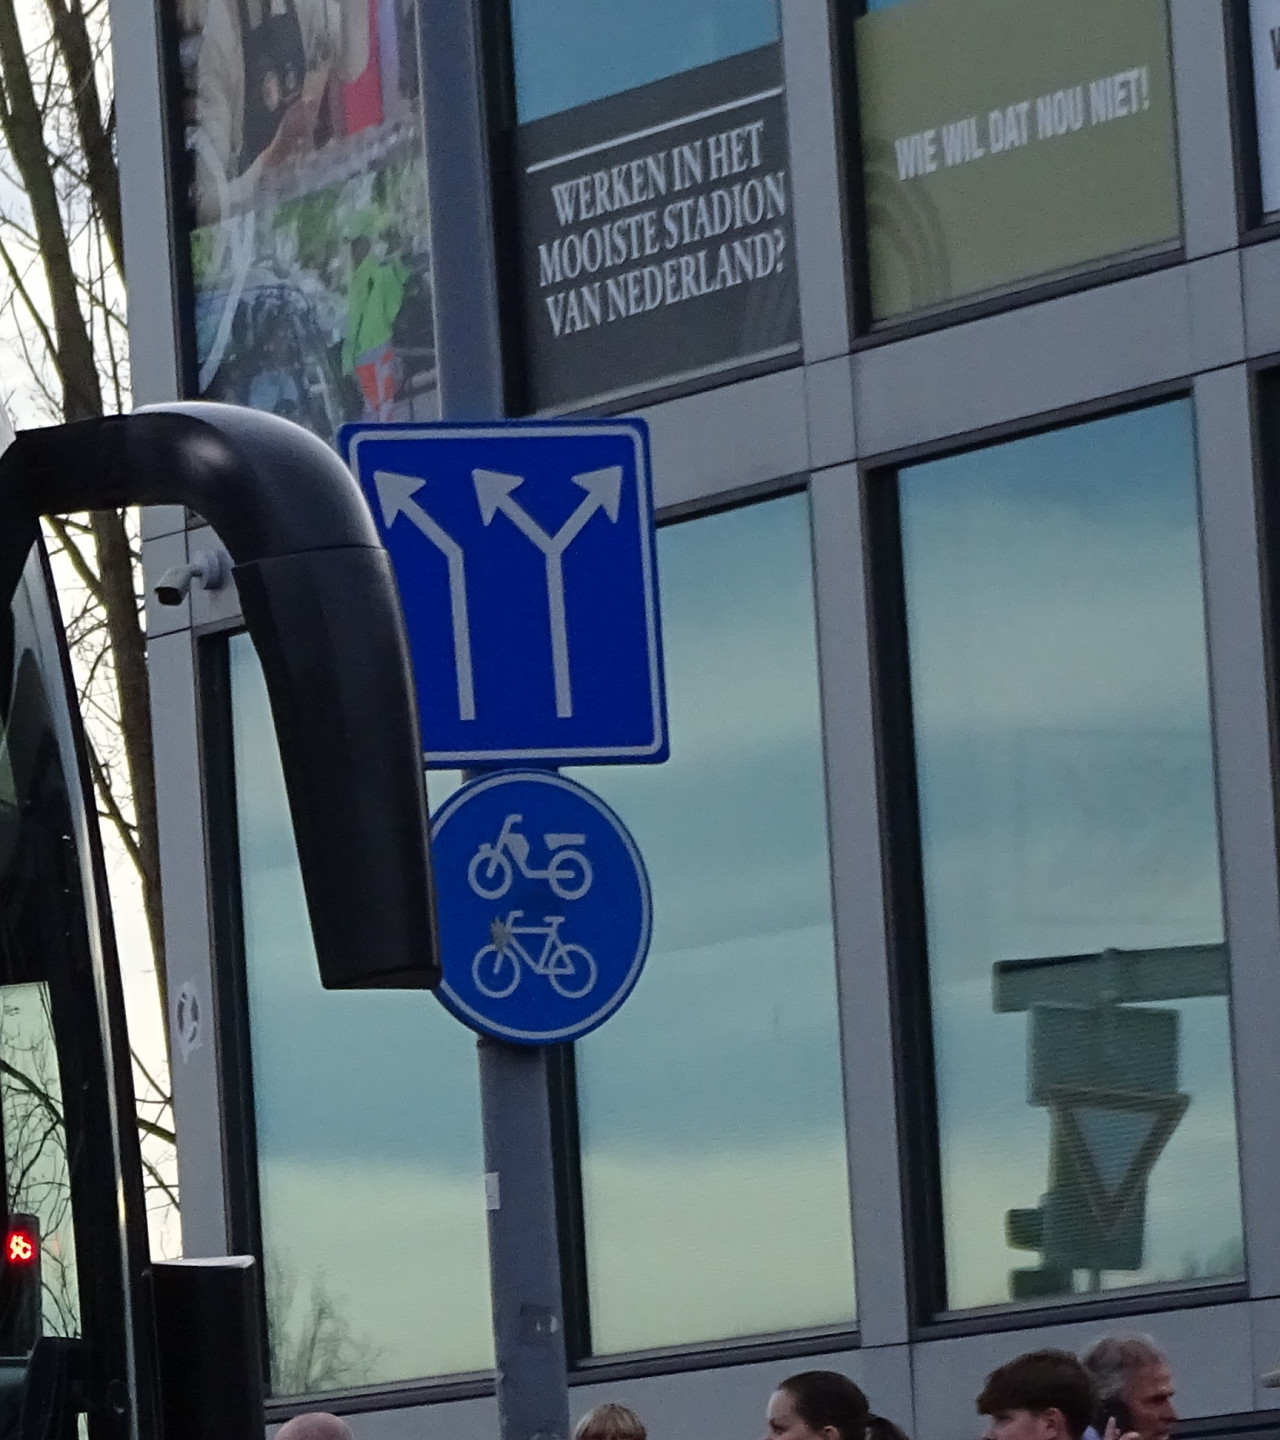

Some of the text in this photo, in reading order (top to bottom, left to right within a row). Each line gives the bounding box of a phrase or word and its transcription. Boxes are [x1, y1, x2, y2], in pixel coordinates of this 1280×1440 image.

[551, 120, 764, 227] WERKEN IN HET
[895, 65, 1150, 181] WIE WIL DAT NOU NIET!
[538, 172, 786, 287] MOOISTE STADION
[545, 228, 786, 338] VAN NEDERLAND?
